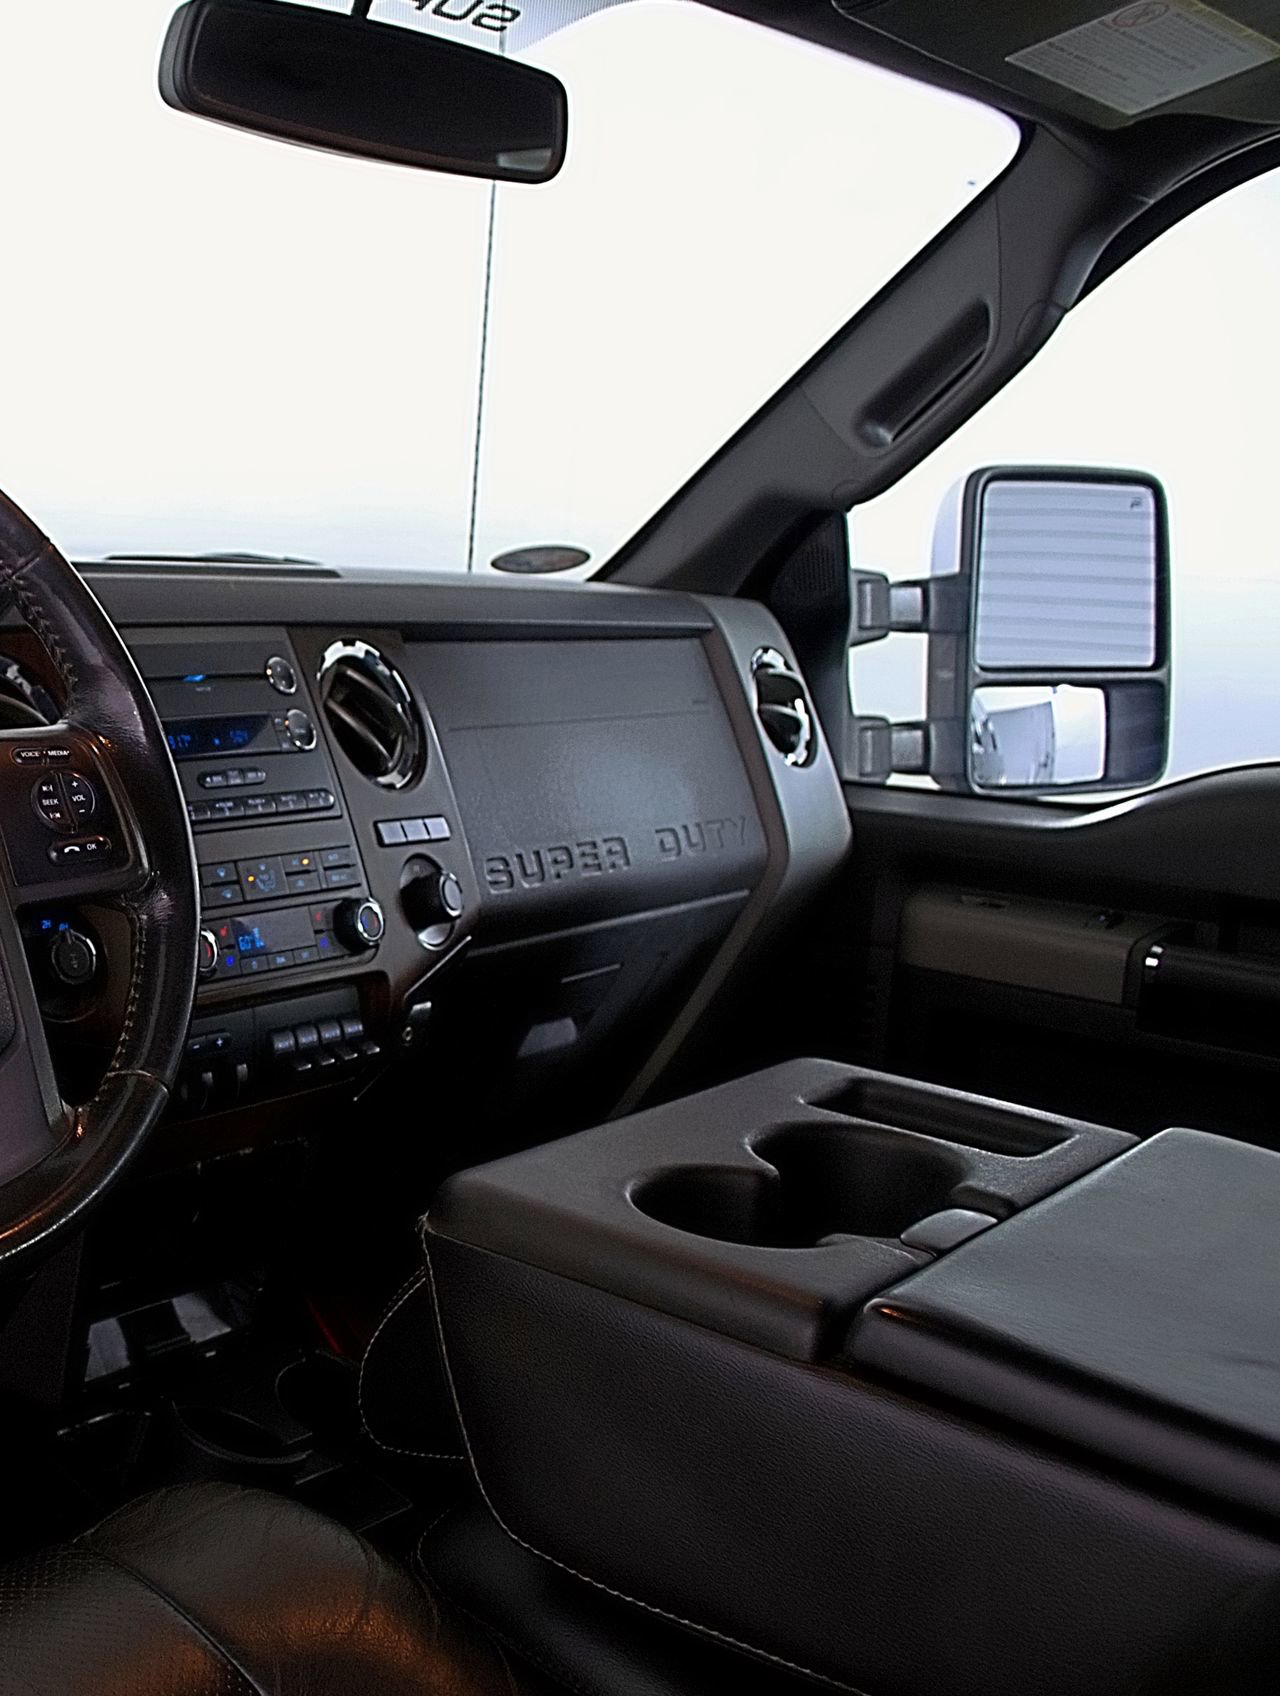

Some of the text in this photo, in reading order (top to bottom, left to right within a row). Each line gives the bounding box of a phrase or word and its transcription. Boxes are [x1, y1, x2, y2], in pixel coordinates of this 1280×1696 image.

[42, 798, 59, 806] SEEK
[72, 794, 86, 802] VOL
[86, 843, 97, 851] OK
[485, 815, 746, 894] SUPER DUTY
